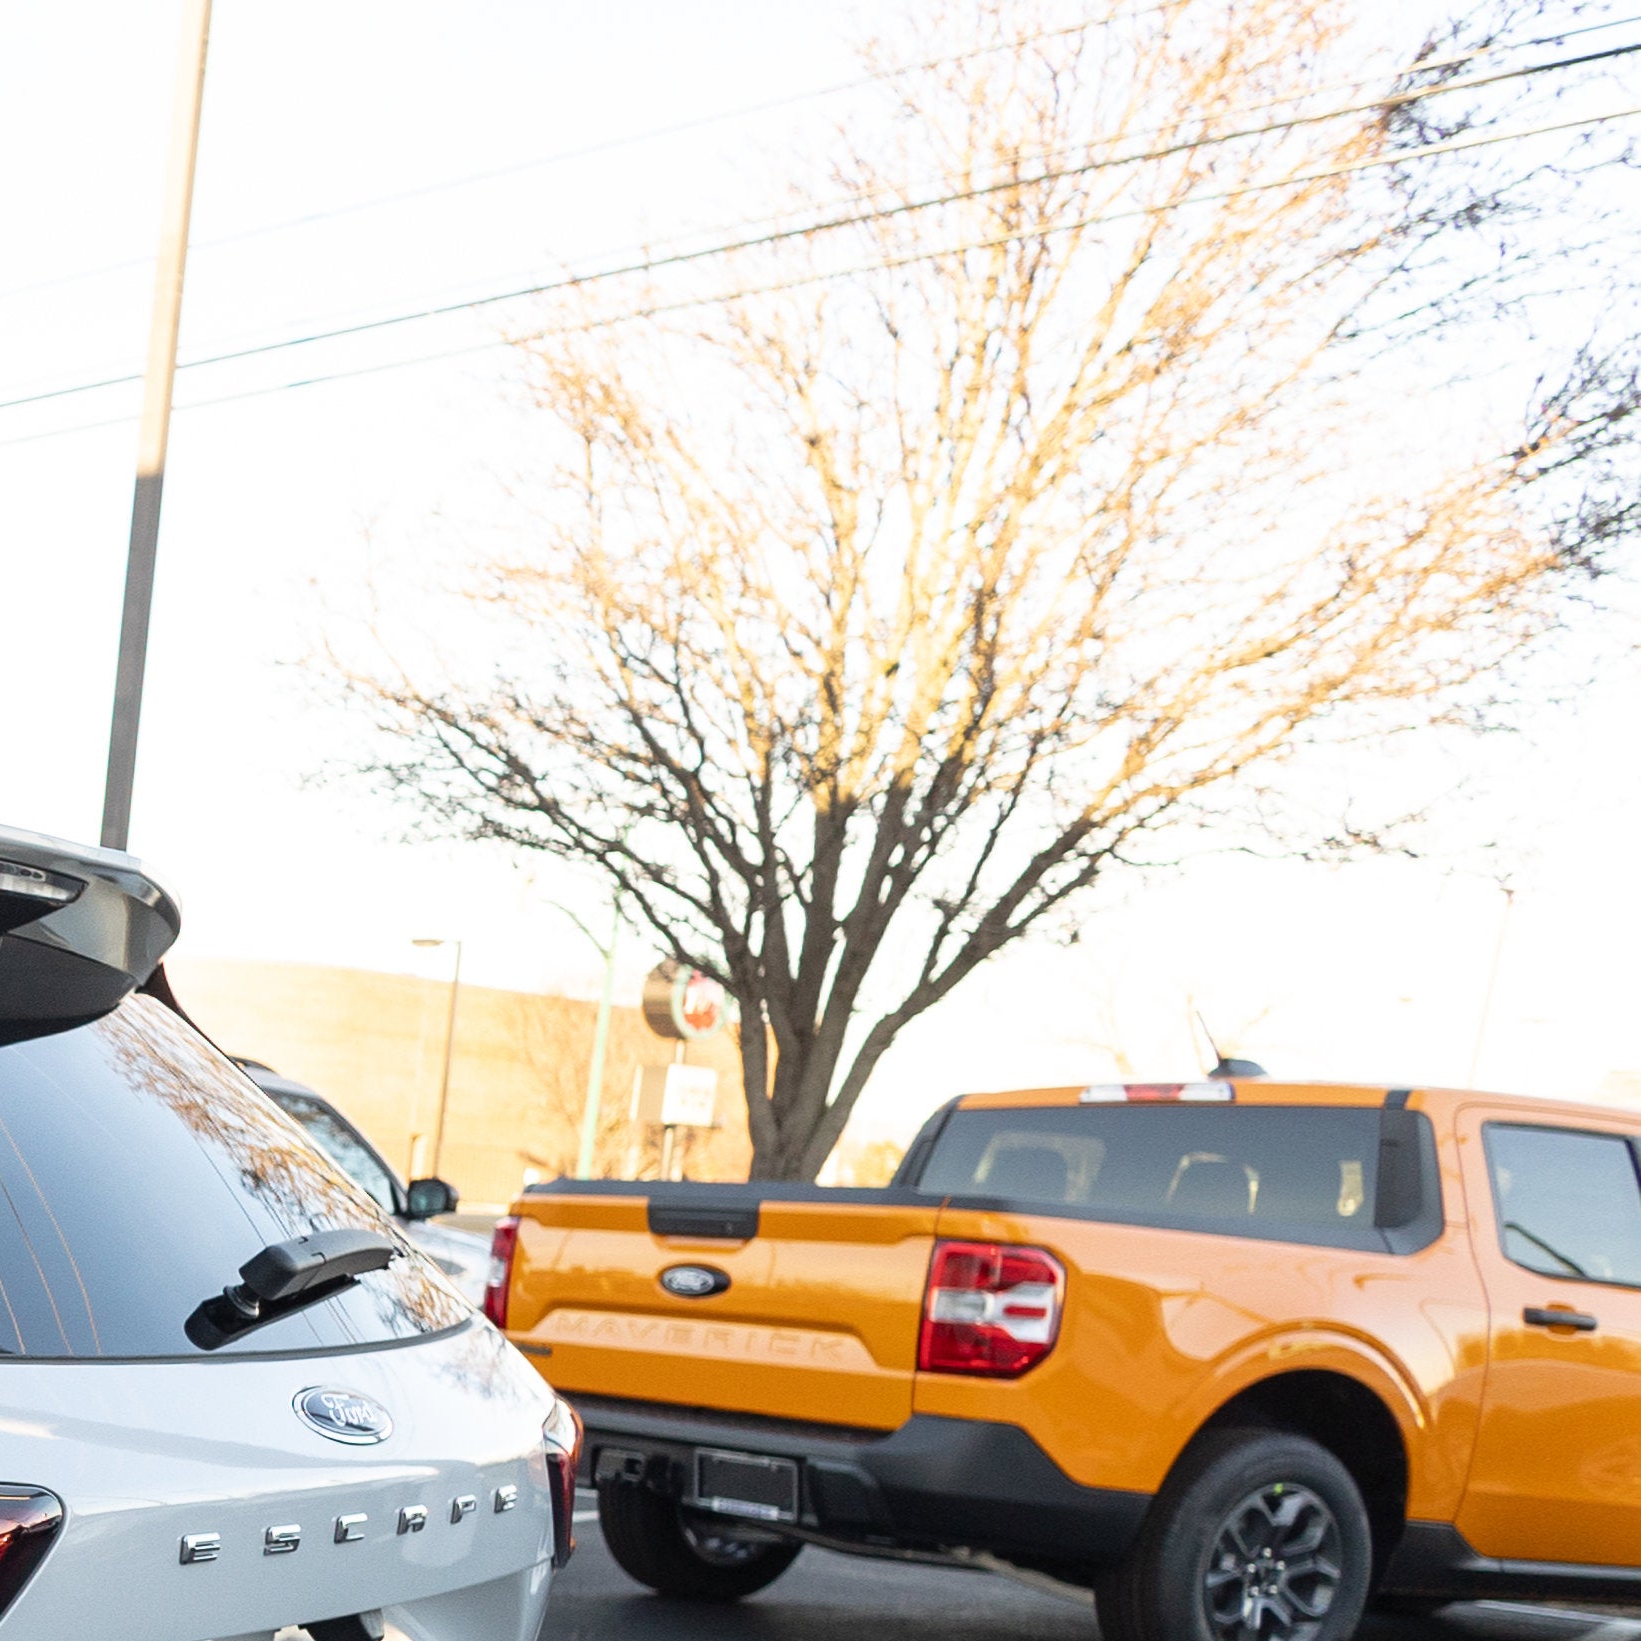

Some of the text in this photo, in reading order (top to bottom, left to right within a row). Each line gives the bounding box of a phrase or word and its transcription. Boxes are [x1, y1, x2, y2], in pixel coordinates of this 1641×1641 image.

[554, 1313, 844, 1361] MAVERICK
[321, 1393, 378, 1427] Ford
[179, 1484, 519, 1566] ESCAPE
